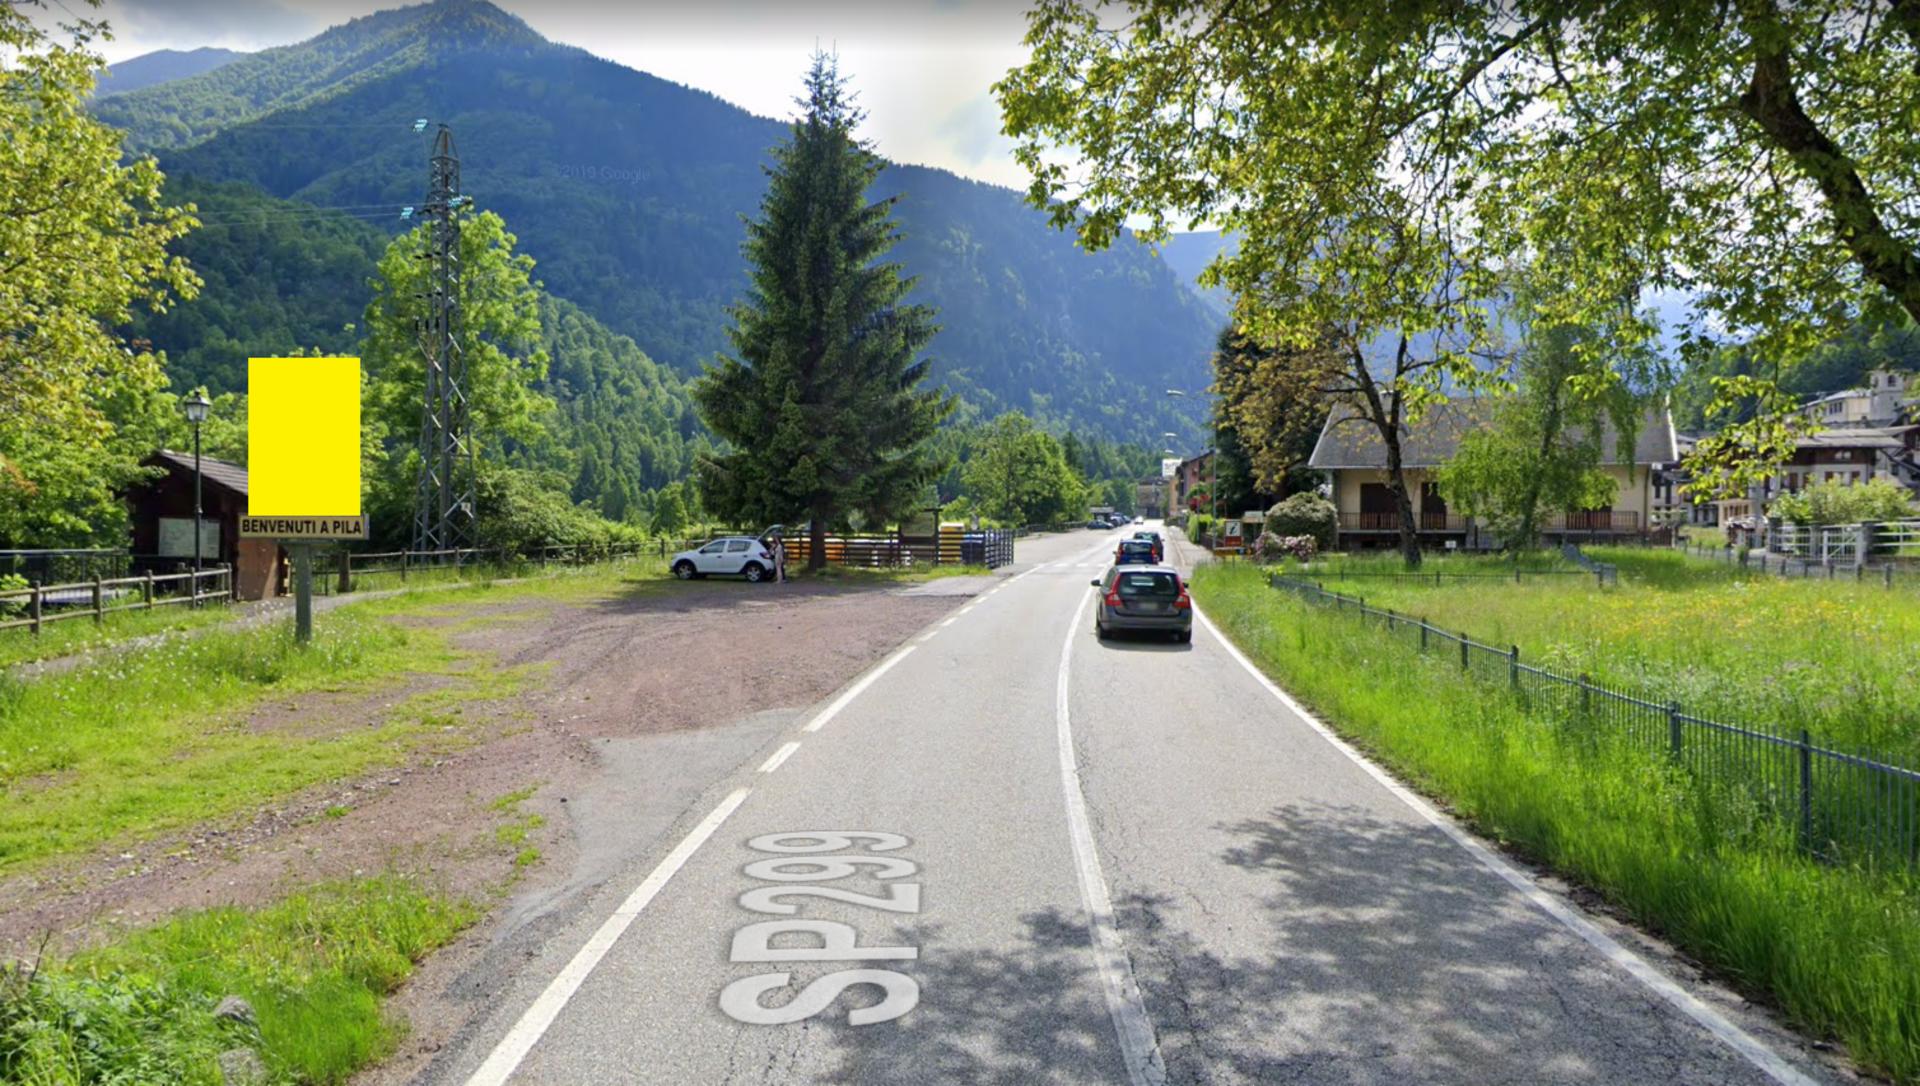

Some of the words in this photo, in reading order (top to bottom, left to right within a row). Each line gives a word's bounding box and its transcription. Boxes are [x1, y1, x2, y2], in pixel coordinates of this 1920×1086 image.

[242, 519, 317, 534] BENVENUTI
[320, 520, 330, 534] A
[332, 520, 362, 534] PILA
